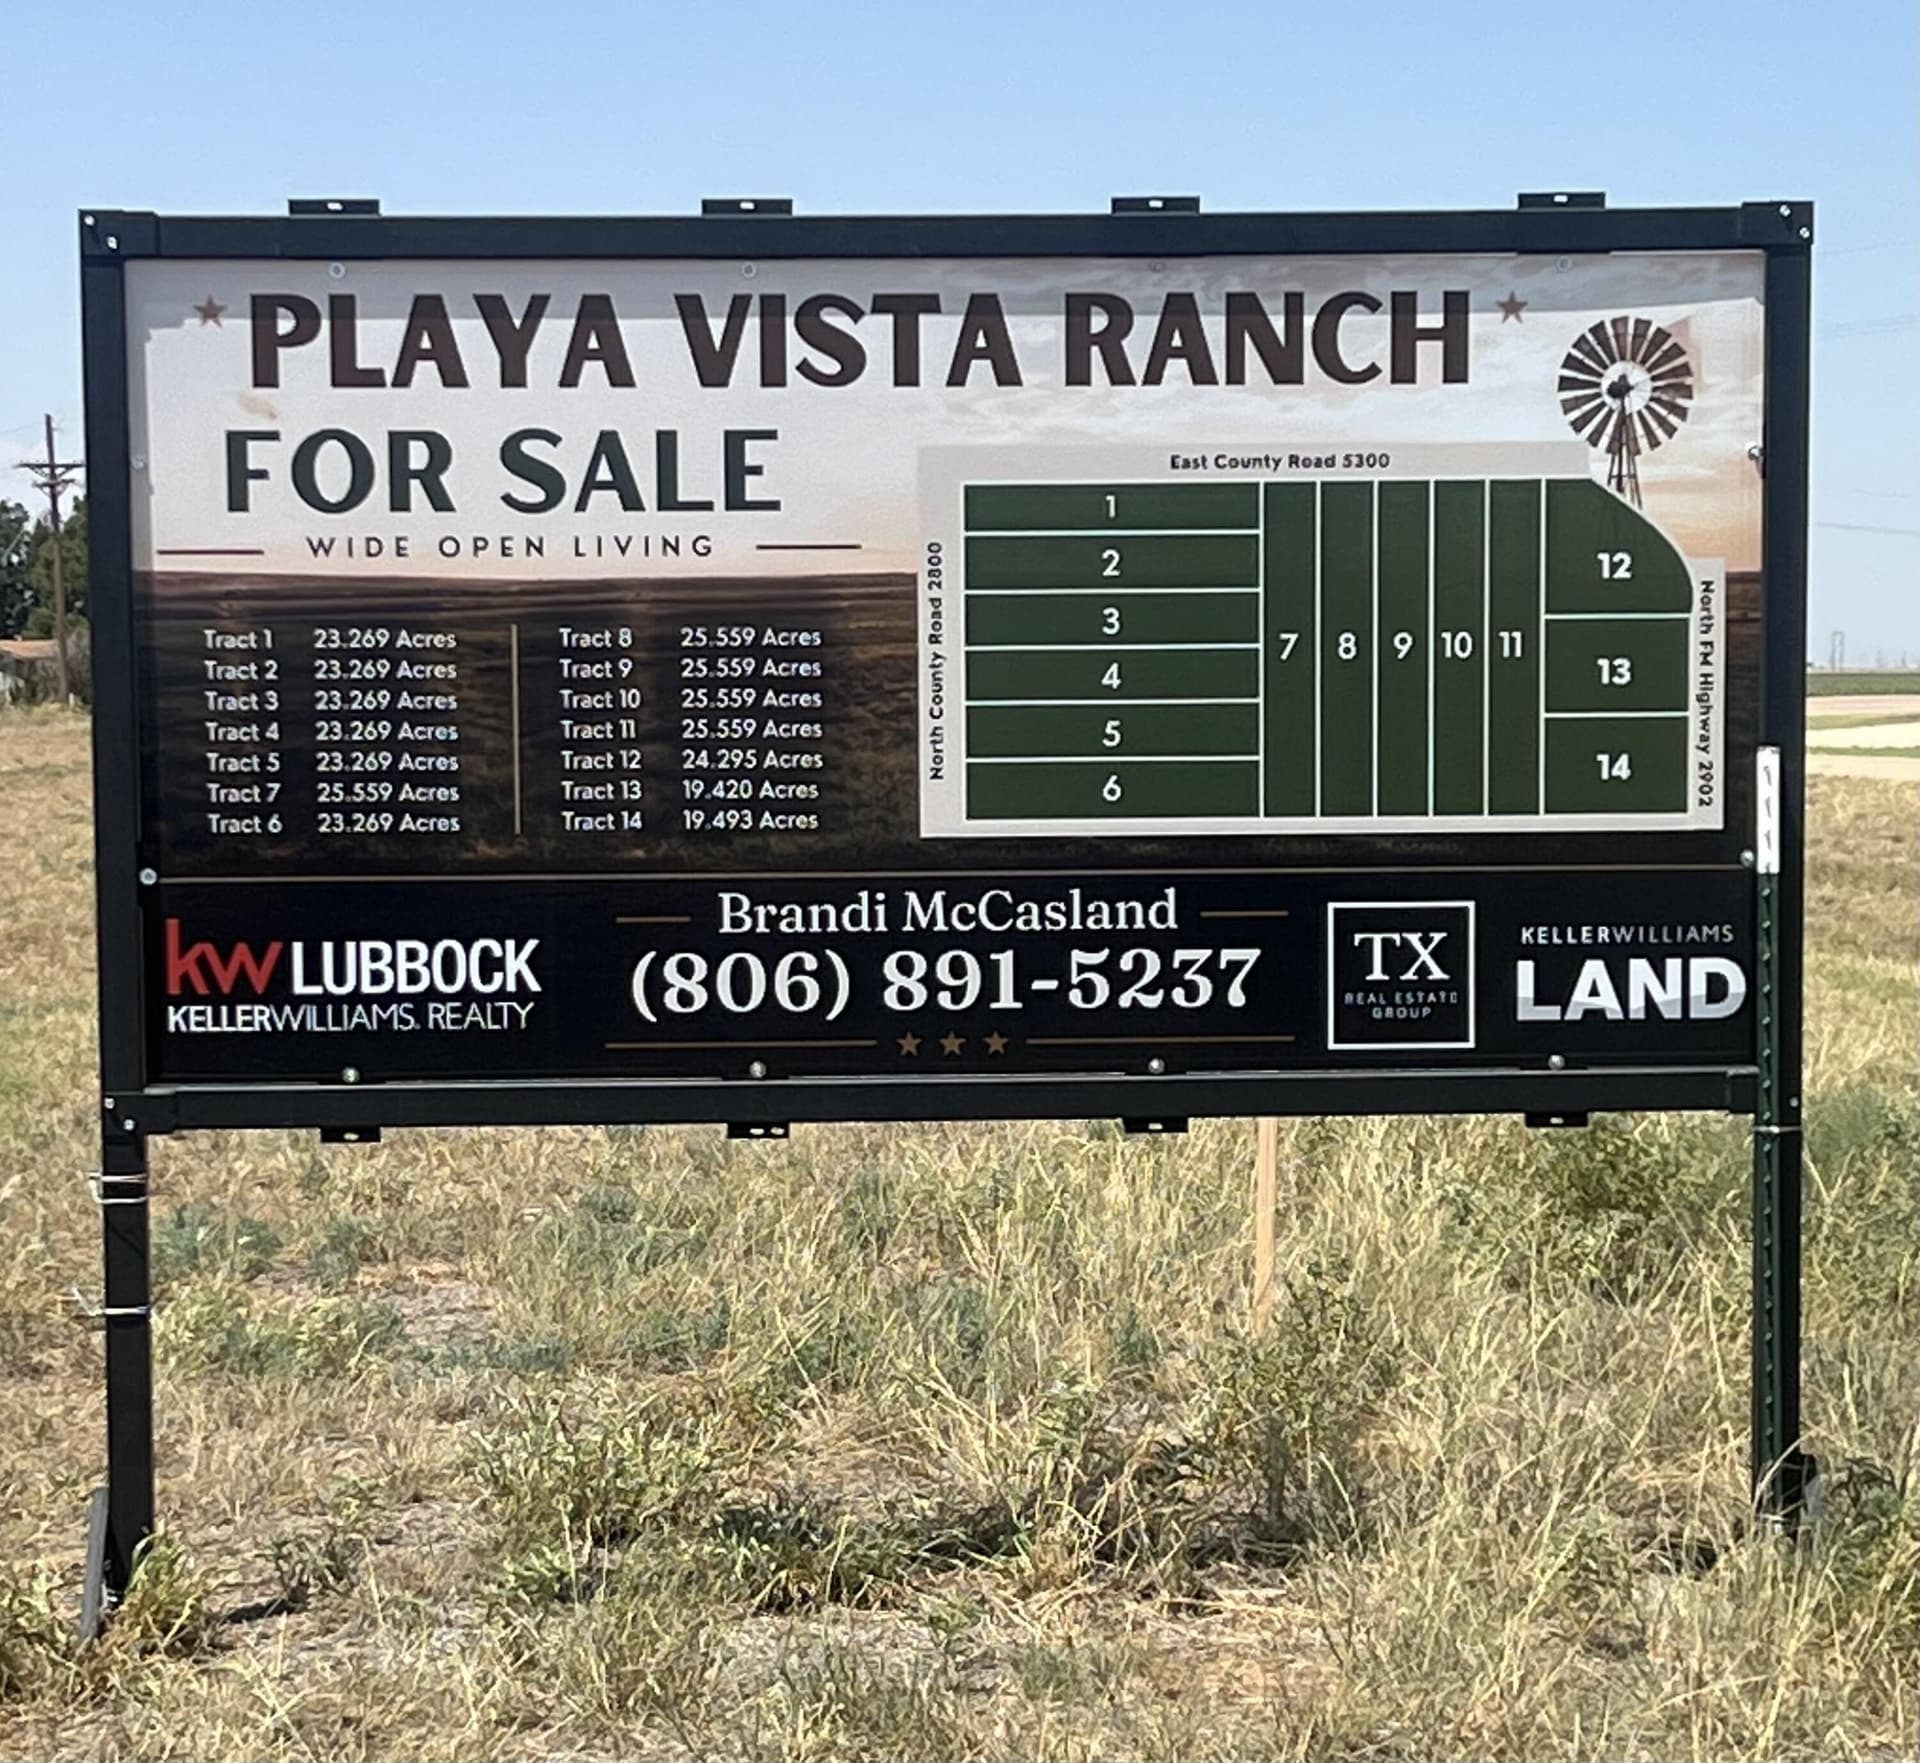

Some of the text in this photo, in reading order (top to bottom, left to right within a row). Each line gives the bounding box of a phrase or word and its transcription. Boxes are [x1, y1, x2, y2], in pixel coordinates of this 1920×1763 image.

[249, 290, 1471, 390] PLAYA VISTA RANCH
[225, 428, 781, 514] FOR SALE
[1170, 454, 1390, 472] East County Road 5300
[1105, 496, 1116, 518] 1
[306, 535, 714, 558] WIDE OPEN LIVING
[1101, 551, 1121, 576] 2
[1597, 553, 1631, 579] 12
[1101, 609, 1121, 634] 3
[204, 629, 457, 649] Tract 1 23.269 Acres
[559, 628, 821, 648] Tract 8 25.559 Acres
[1279, 634, 1299, 659] 7
[1337, 634, 1356, 659] 8
[1393, 633, 1412, 659] 9
[1440, 632, 1473, 658] 10
[1498, 632, 1523, 658] 11
[205, 659, 457, 680] Tract 2 23.269 Acres
[559, 658, 821, 679] Tract 9 25.559 Acres
[928, 542, 947, 780] North County Road 2800
[1597, 659, 1631, 685] 13
[1101, 664, 1121, 689] 4
[205, 690, 458, 711] Tract 3 23.269 Acres
[560, 689, 821, 709] Tract 10 25.559 Acres
[1696, 581, 1714, 807] North FM Highway 2902
[206, 721, 459, 742] Tract 4 23.269 Acres
[560, 719, 822, 740] Tract 11 25.559 Acres
[1103, 721, 1121, 746] 5
[206, 752, 459, 772] Tract 5 23.269 Acres
[561, 749, 823, 770] Tract 12 24.295 Acres
[1596, 754, 1631, 779] 14
[207, 782, 460, 803] Tract 7 25.559 Acres
[561, 780, 819, 801] Tract 13 19.420 Acres
[1103, 777, 1121, 802] 6
[208, 813, 461, 834] Tract 6 23.269 Acres
[561, 810, 819, 831] Tract 14 19.493 Acres
[718, 887, 1178, 935] Brandi McCasland
[1521, 924, 1735, 945] KELLERWILLIAMS
[166, 918, 542, 994] kw LUBBOCK
[1353, 932, 1451, 981] TX
[632, 948, 1261, 1022] (806) 891-5237
[1344, 990, 1458, 1005] REAL ESTATE
[1516, 957, 1747, 1021] LAND
[428, 1002, 534, 1030] REALTY
[1372, 1007, 1431, 1019] GROUP
